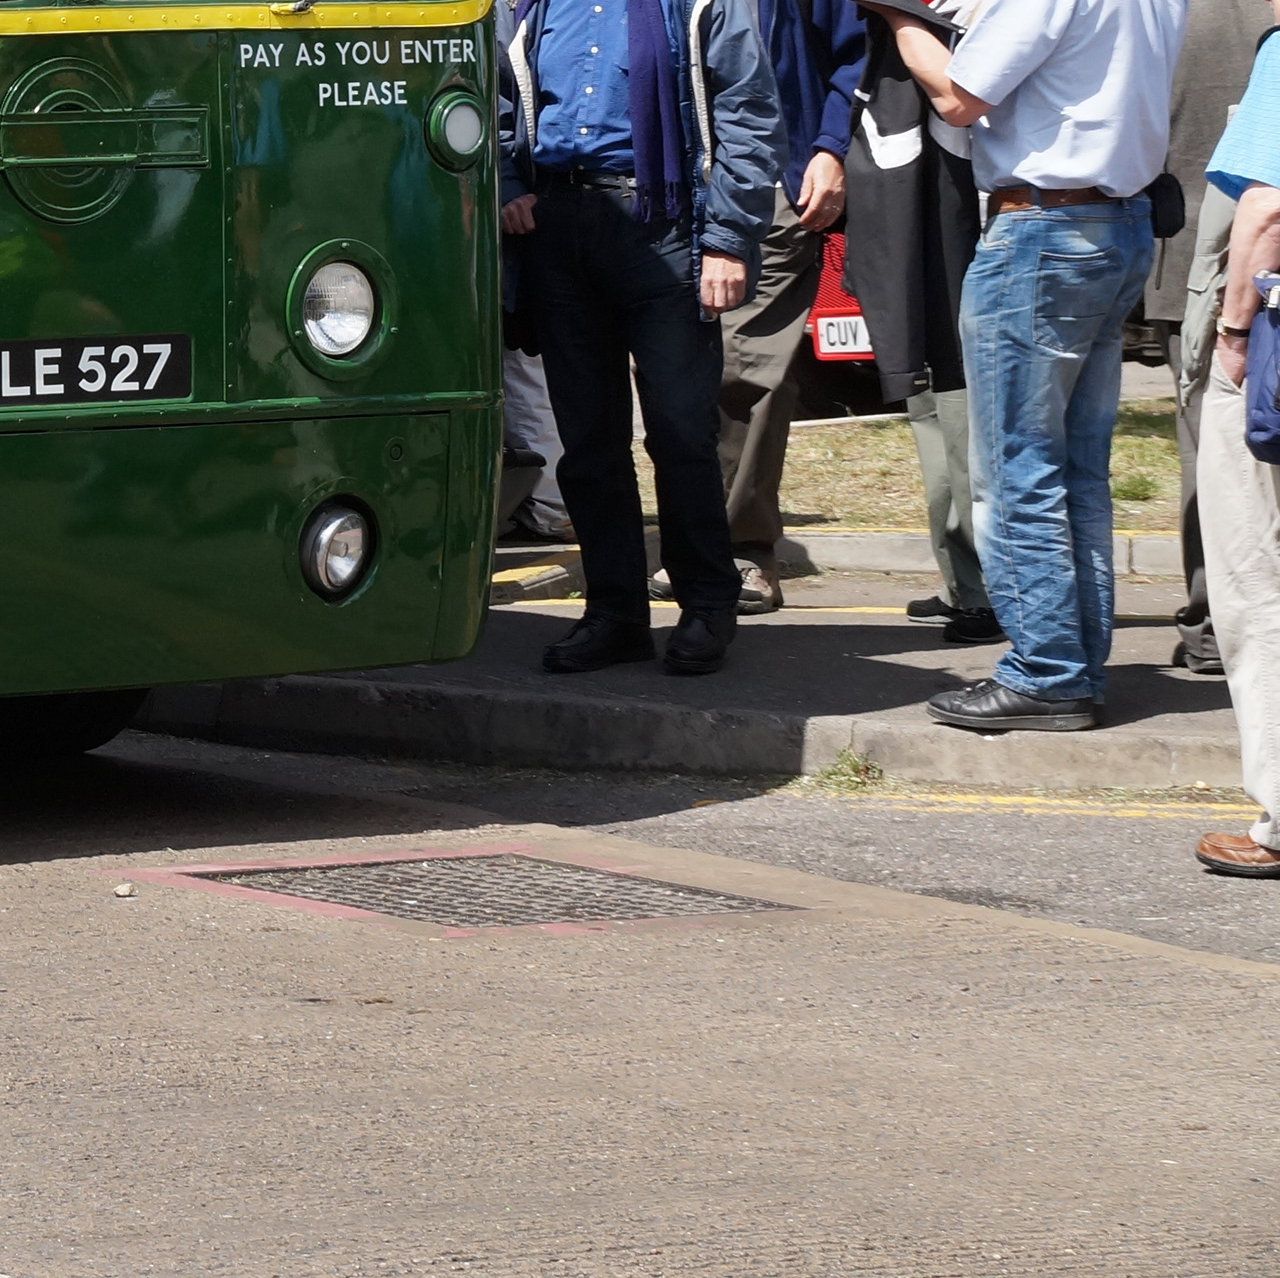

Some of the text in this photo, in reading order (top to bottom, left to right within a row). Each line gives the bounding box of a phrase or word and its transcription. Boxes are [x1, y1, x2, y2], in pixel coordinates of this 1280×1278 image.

[239, 39, 476, 68] PAY AS YOU ENTER
[318, 80, 408, 107] PLEASE
[826, 321, 859, 346] CUV
[78, 342, 172, 393] 527
